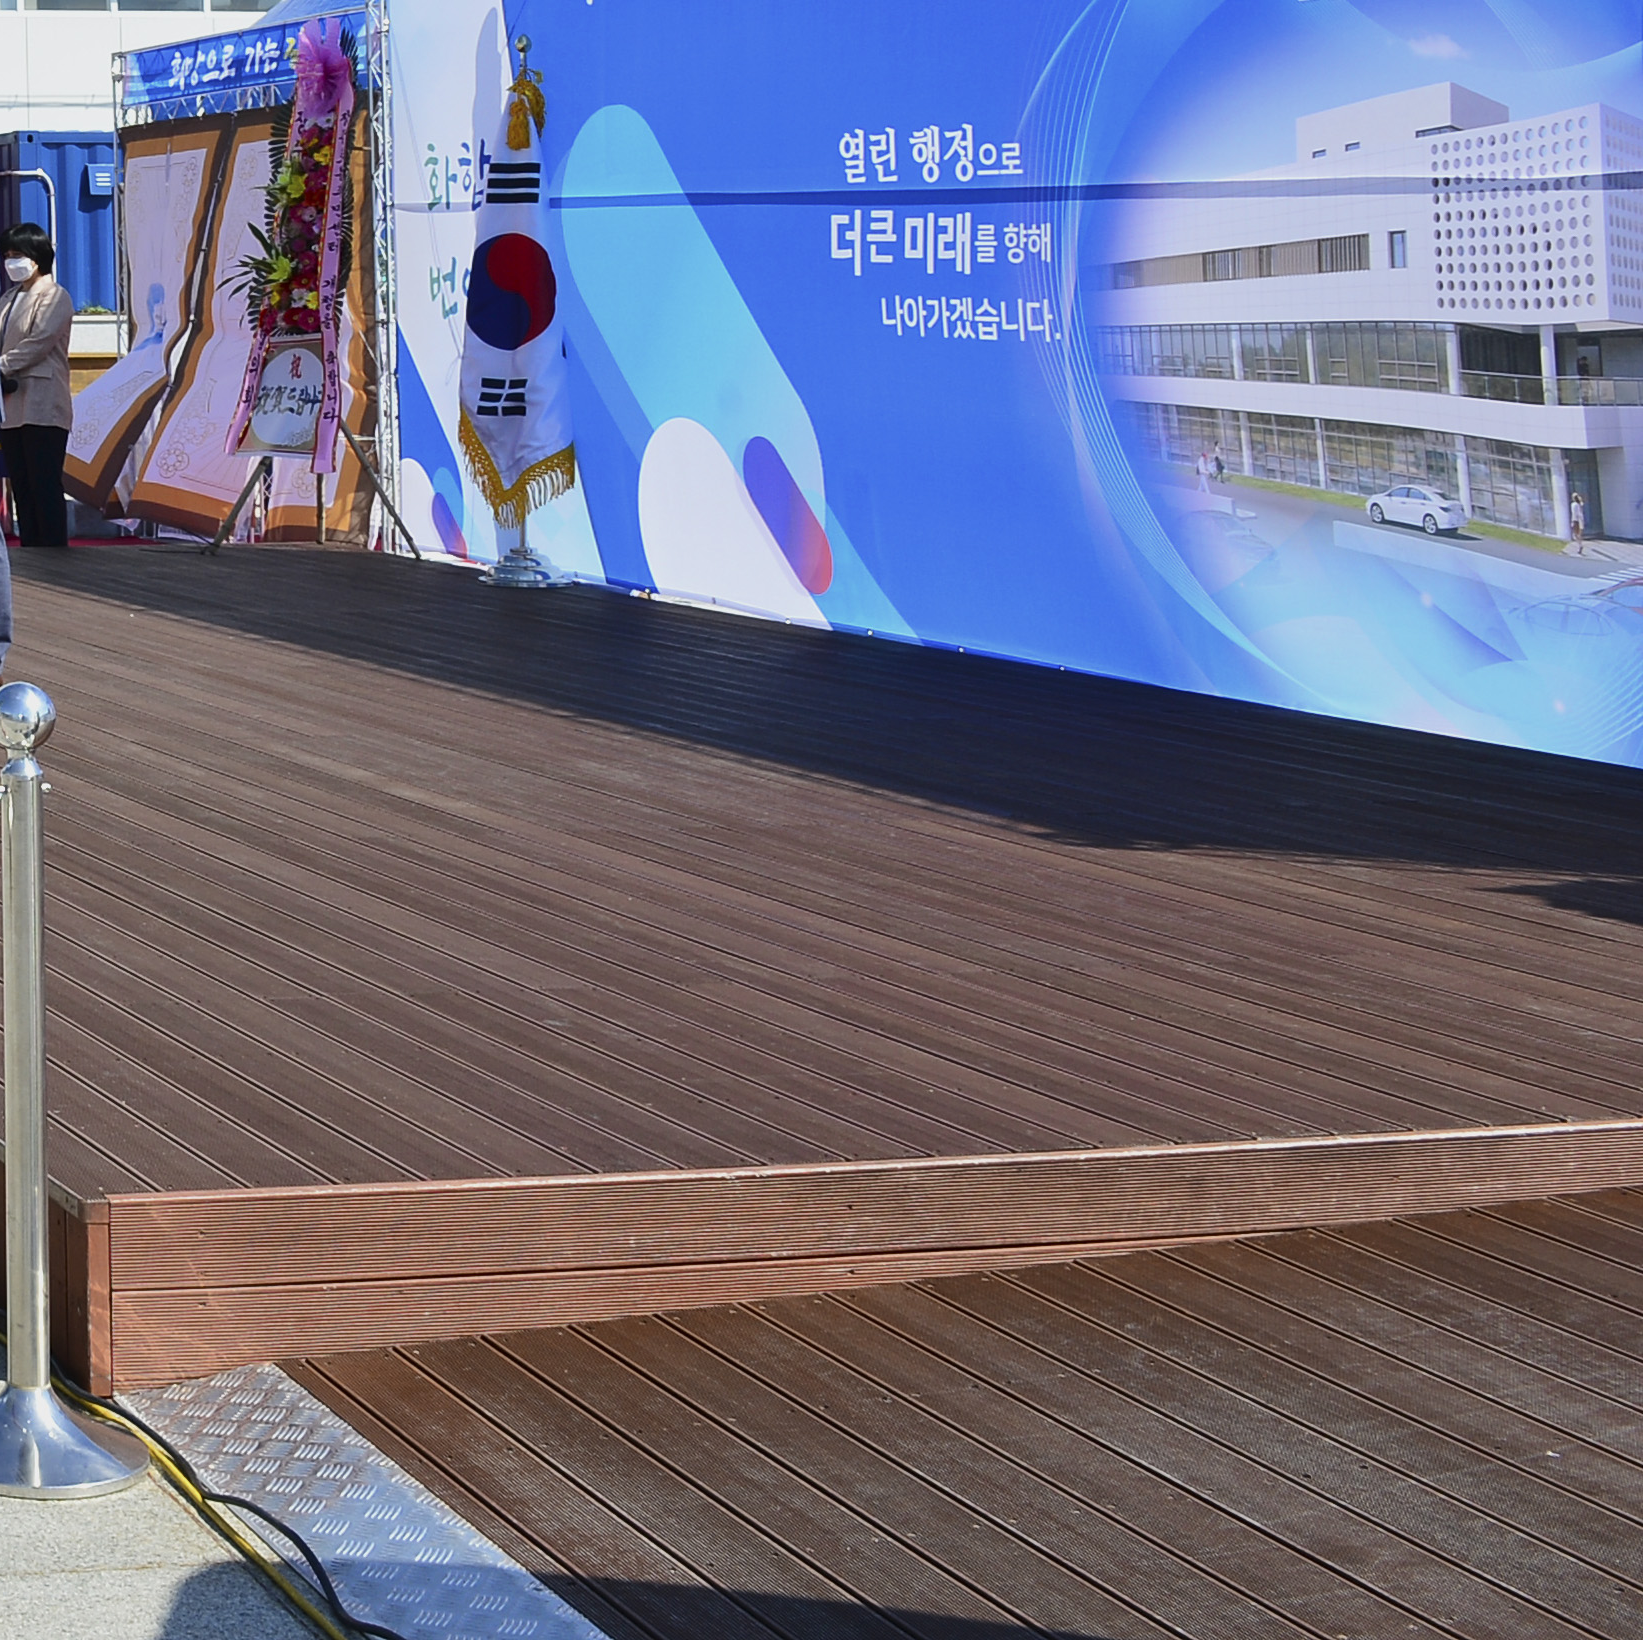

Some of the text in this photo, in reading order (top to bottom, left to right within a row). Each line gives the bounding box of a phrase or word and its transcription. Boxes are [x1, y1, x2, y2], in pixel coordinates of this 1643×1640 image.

[168, 44, 237, 91] 희망으로
[244, 36, 281, 74] 가는
[838, 123, 1024, 184] 열린 행정으로
[903, 211, 999, 275] 미래를
[1002, 221, 1052, 264] 향해
[429, 256, 472, 320] 번
[880, 294, 1062, 343] 나아가겠습니다.
